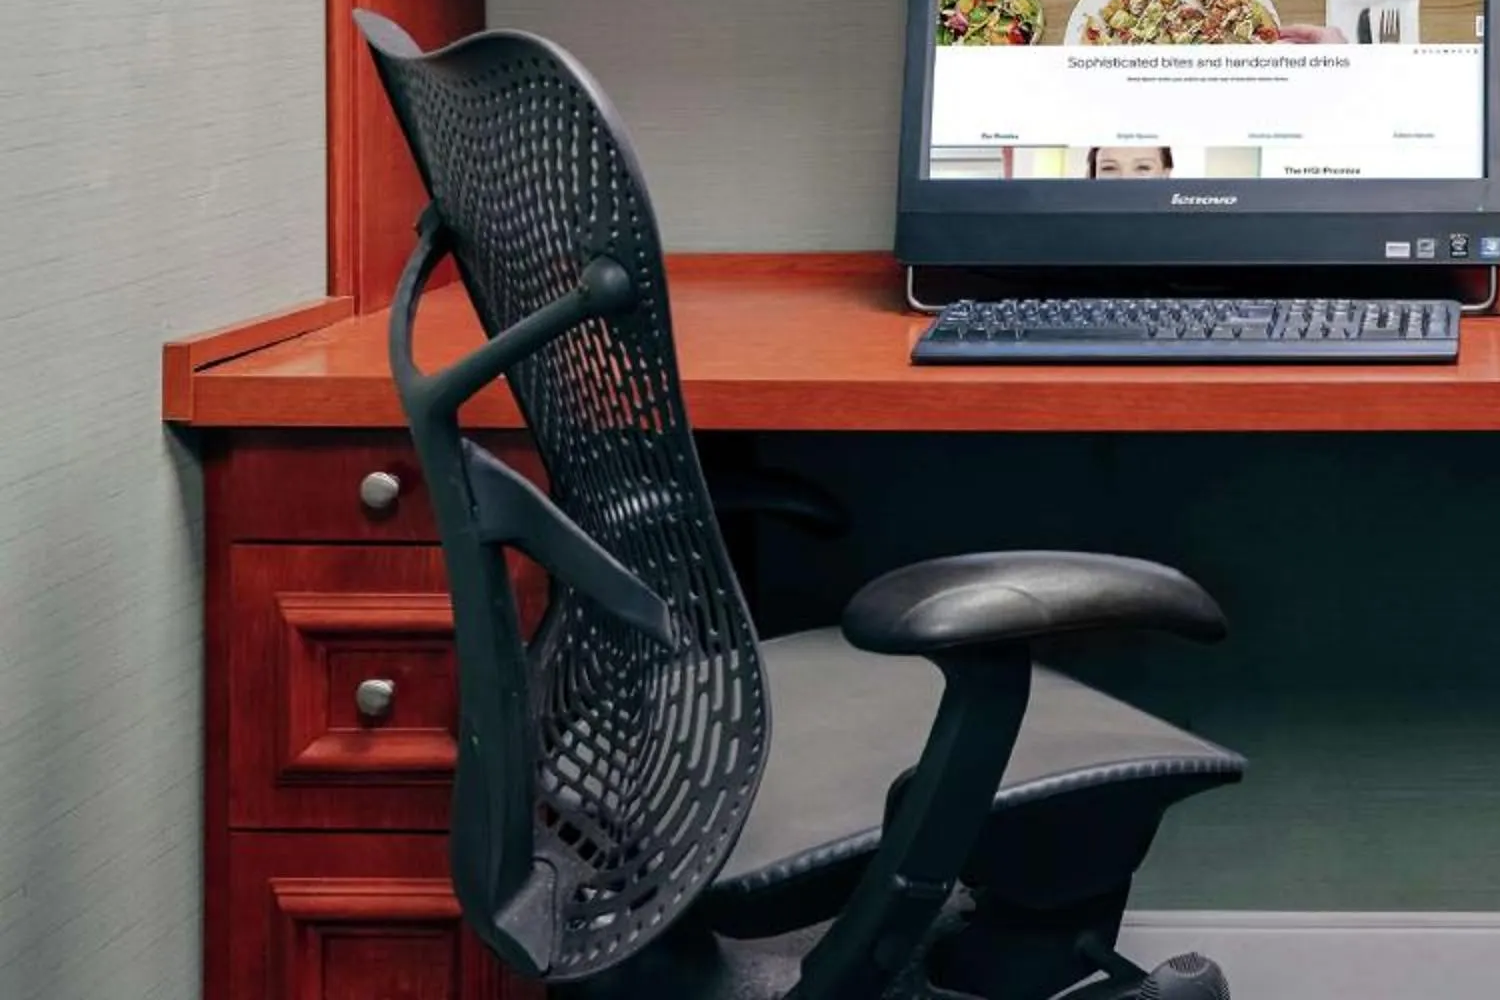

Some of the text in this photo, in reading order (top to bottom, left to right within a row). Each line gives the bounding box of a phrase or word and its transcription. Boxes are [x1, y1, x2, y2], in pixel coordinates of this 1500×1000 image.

[1067, 56, 1350, 70] Sophisticated bites and handcrafted drinks
[1171, 193, 1238, 205] lenovo
